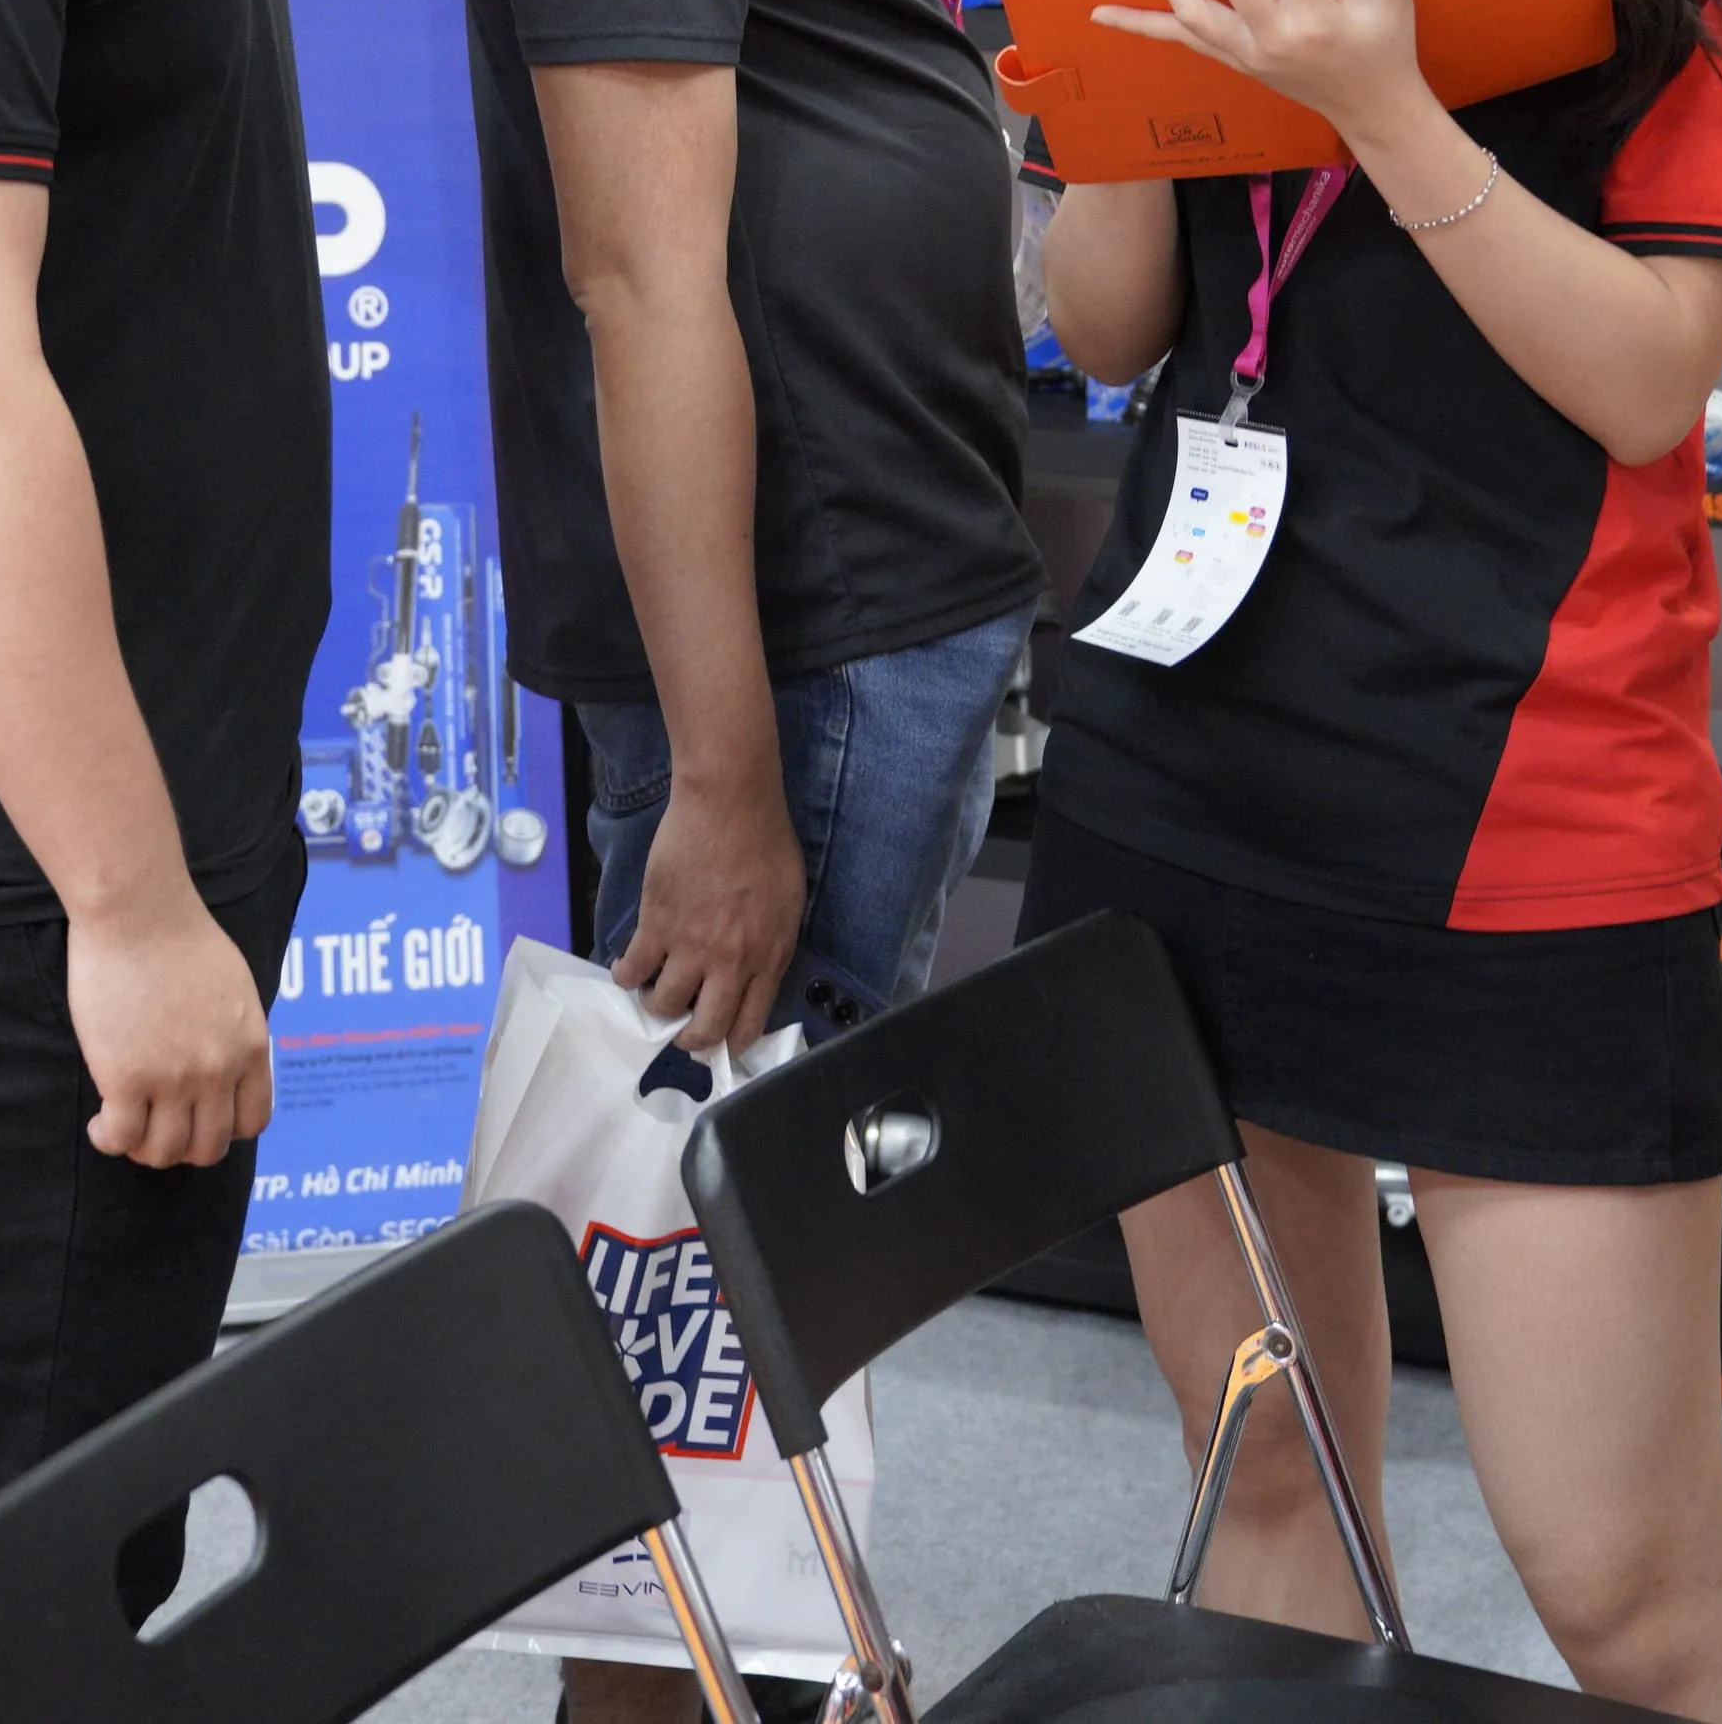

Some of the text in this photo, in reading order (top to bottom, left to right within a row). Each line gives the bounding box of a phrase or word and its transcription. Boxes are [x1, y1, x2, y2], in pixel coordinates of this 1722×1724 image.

[314, 914, 486, 997] THẾ GIỚI
[300, 1163, 341, 1197] Hồ
[345, 1164, 389, 1193] Chí
[394, 1158, 464, 1190] Minh
[586, 1237, 714, 1316] LIFE
